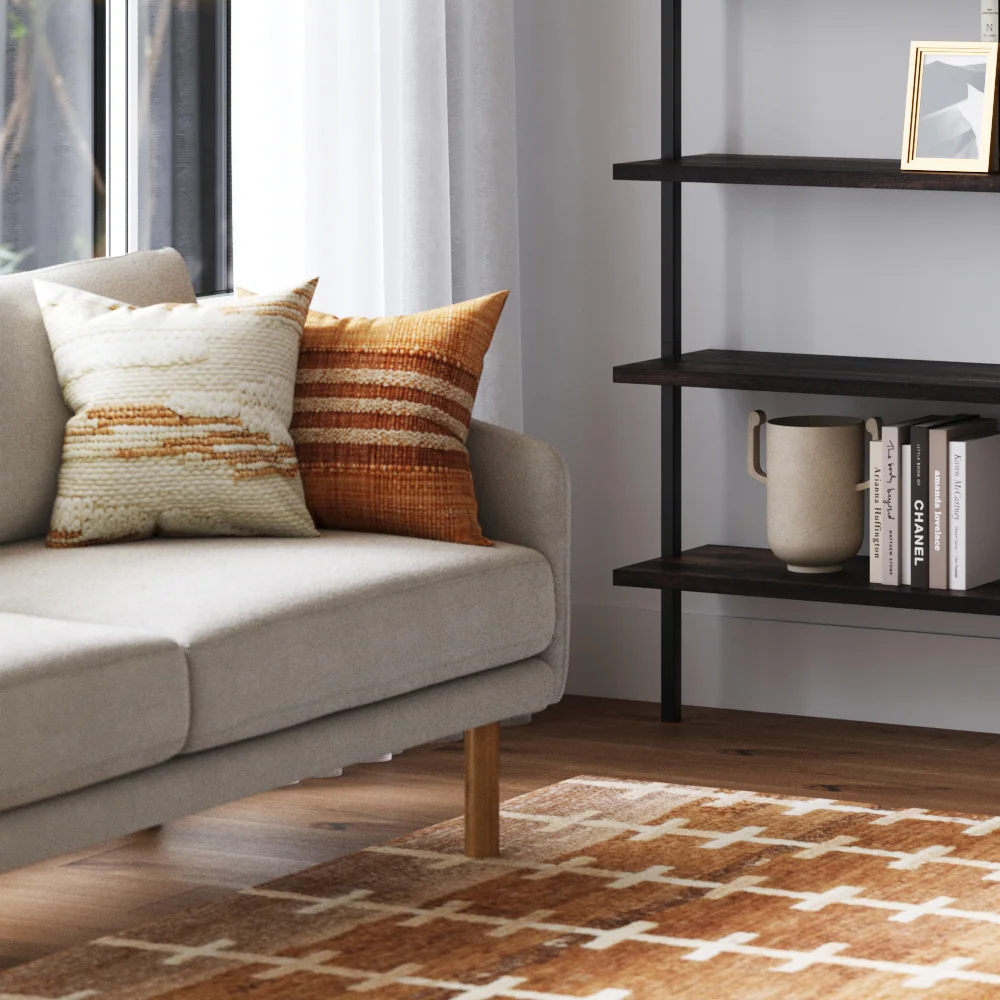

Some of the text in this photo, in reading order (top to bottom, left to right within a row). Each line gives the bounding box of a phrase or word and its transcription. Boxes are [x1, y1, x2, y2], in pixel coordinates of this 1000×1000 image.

[986, 24, 993, 32] N
[887, 463, 896, 484] body
[917, 477, 920, 486] OF
[883, 488, 895, 520] beyond
[952, 479, 961, 520] McCartney
[872, 508, 881, 558] Huffington
[914, 500, 924, 566] CHANEL
